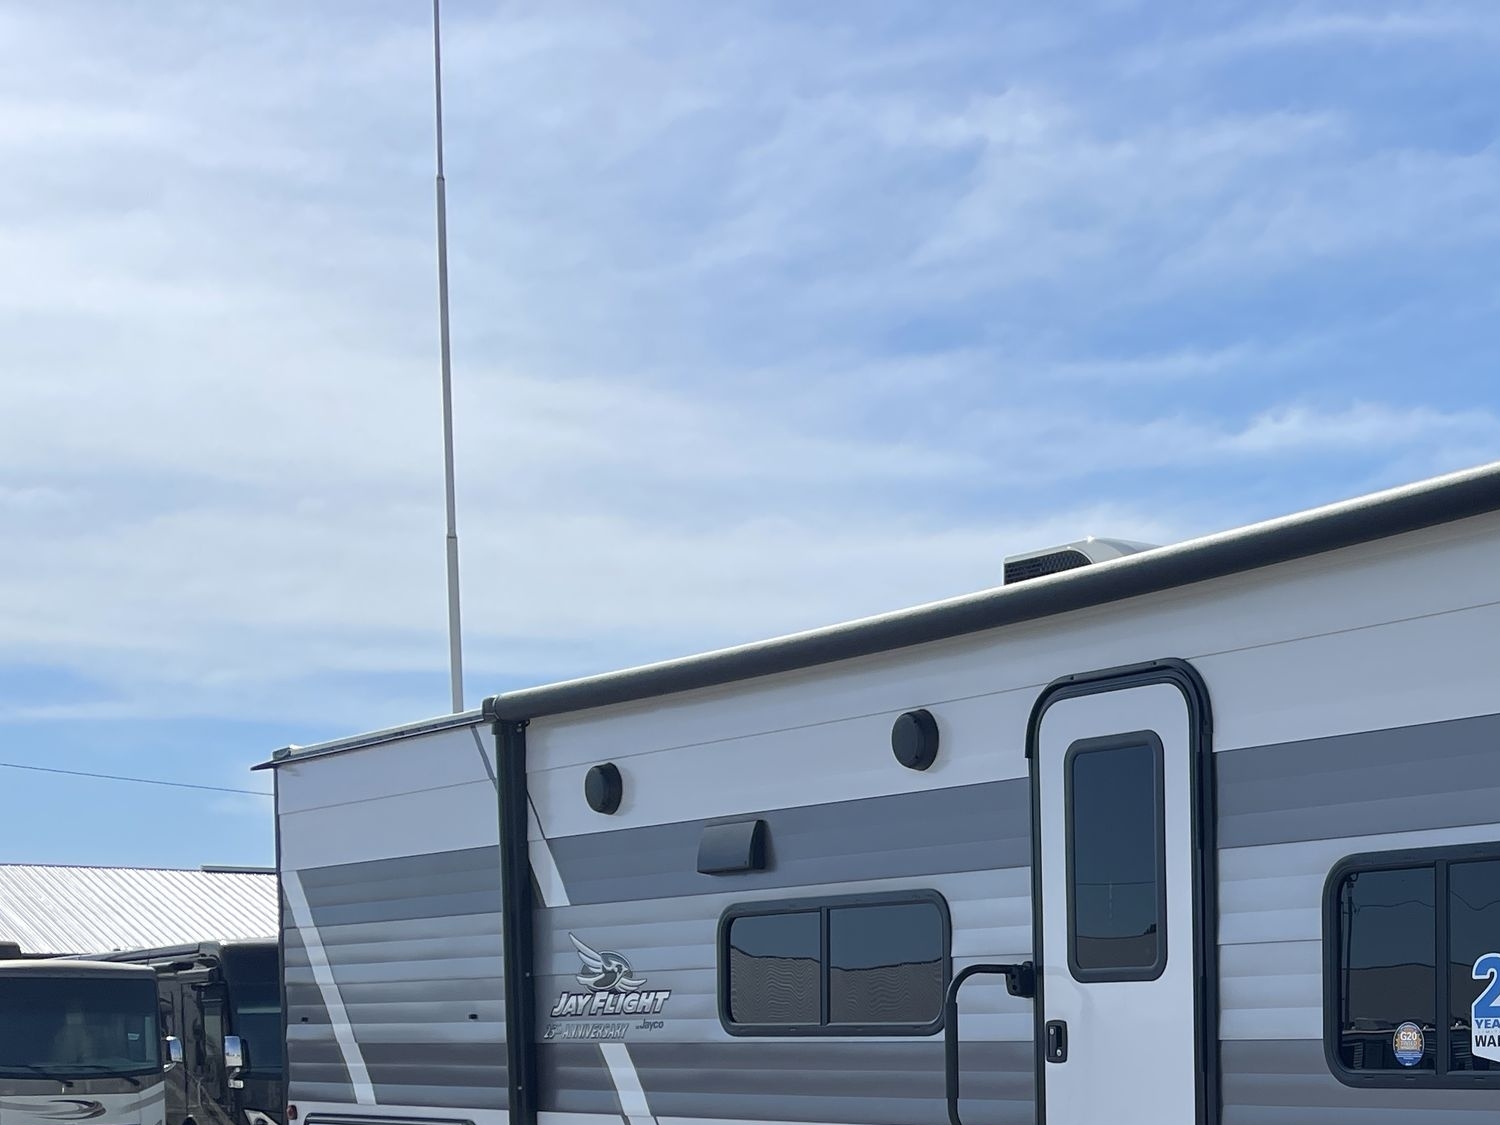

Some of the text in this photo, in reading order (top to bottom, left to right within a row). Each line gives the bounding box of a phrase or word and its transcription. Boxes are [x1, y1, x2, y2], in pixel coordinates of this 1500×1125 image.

[550, 989, 672, 1017] JAY FLIGHT
[561, 1022, 630, 1040] ANNIVERSARY
[640, 1019, 665, 1032] Jayco
[1400, 1031, 1418, 1041] G20
